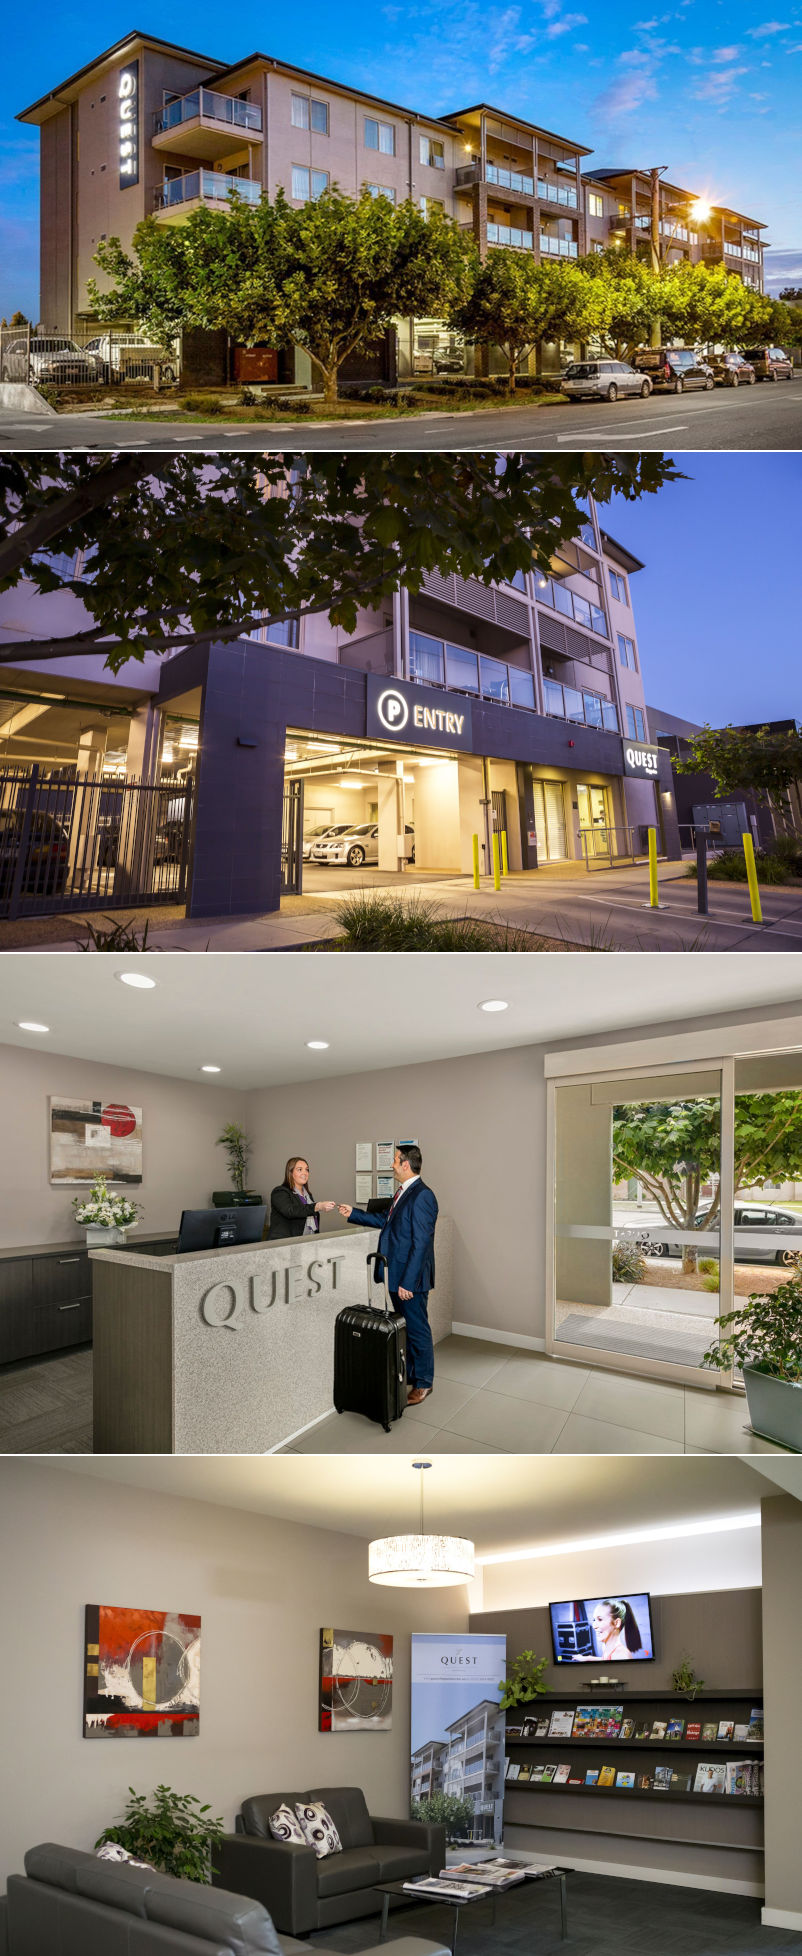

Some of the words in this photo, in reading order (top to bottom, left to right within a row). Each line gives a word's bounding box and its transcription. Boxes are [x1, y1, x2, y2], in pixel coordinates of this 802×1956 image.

[119, 73, 137, 175] QUEST
[387, 699, 401, 722] P
[413, 704, 465, 735] ENTRY
[626, 748, 658, 769] QUEST
[200, 1255, 346, 1332] QUEST
[440, 1656, 478, 1666] QUEST
[699, 1765, 725, 1774] KUDOS
